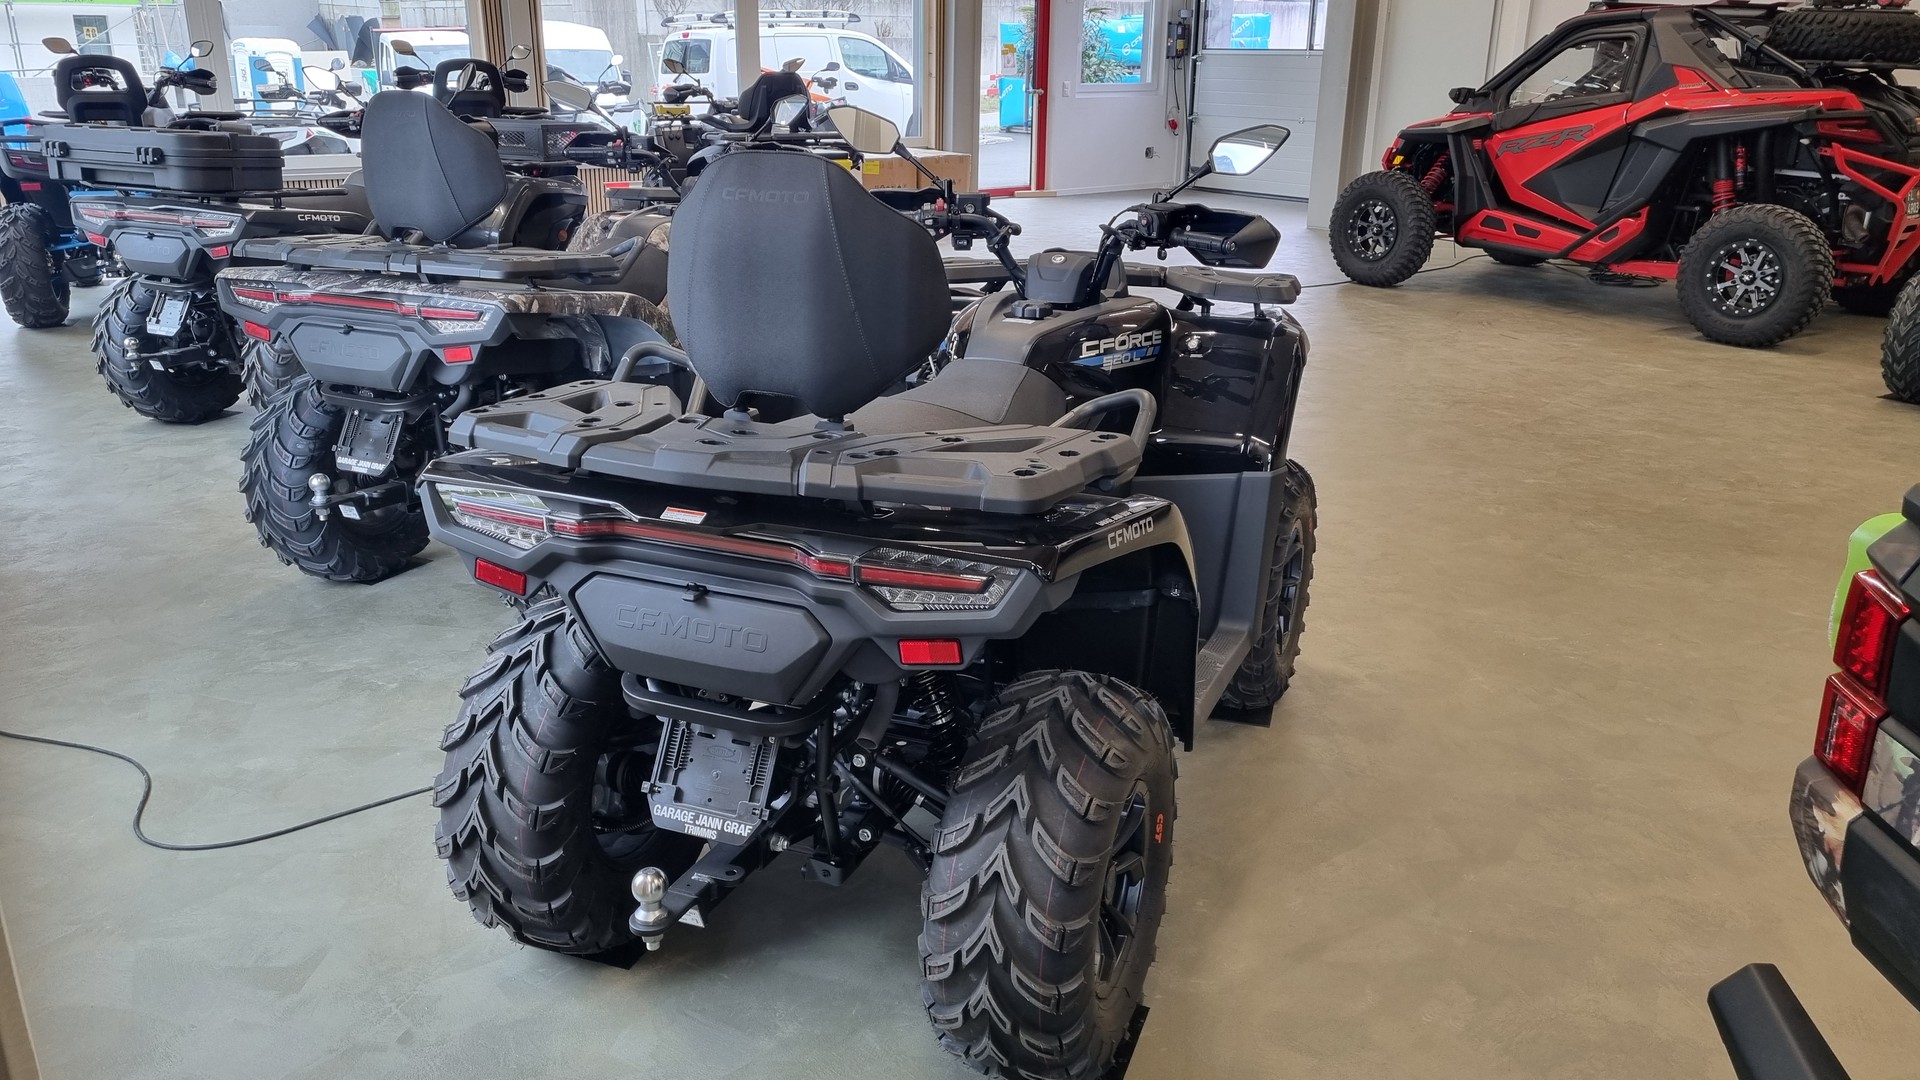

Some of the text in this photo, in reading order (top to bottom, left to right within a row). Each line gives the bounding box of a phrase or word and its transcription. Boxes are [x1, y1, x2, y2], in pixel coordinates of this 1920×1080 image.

[1495, 123, 1596, 160] RZR
[721, 187, 810, 204] CFMOTO
[297, 214, 341, 222] CFMOTO
[1080, 330, 1162, 357] CFORCE
[1103, 351, 1141, 367] 520 L
[1107, 516, 1154, 550] CFMOTO
[615, 603, 769, 653] CFMOTO
[653, 804, 753, 837] GARAGE JANN GRAF
[684, 823, 718, 840] TRIMMIS
[1155, 813, 1164, 844] CST
